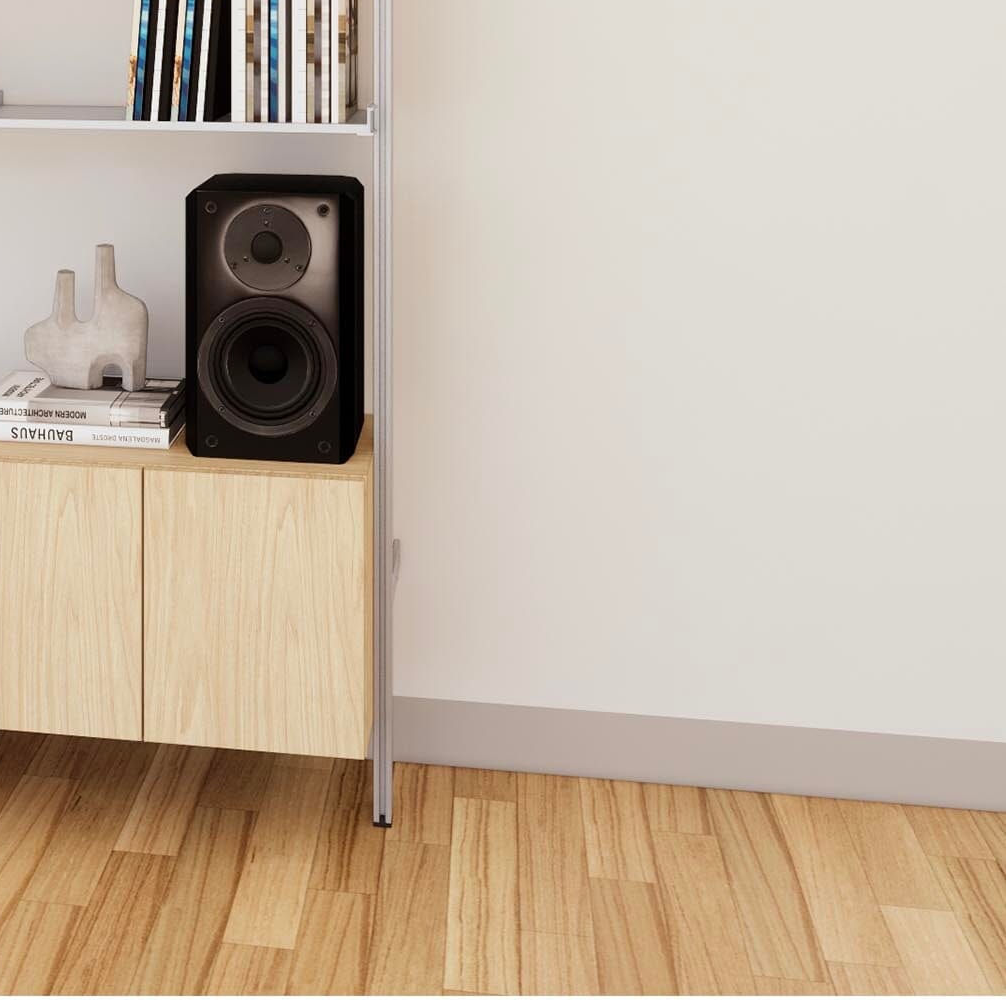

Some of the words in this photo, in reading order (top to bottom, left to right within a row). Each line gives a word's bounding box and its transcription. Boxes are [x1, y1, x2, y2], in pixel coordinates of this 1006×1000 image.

[0, 408, 53, 418] ARCHITECTURE
[55, 410, 86, 419] MODERN
[11, 427, 73, 441] BAUHAUS
